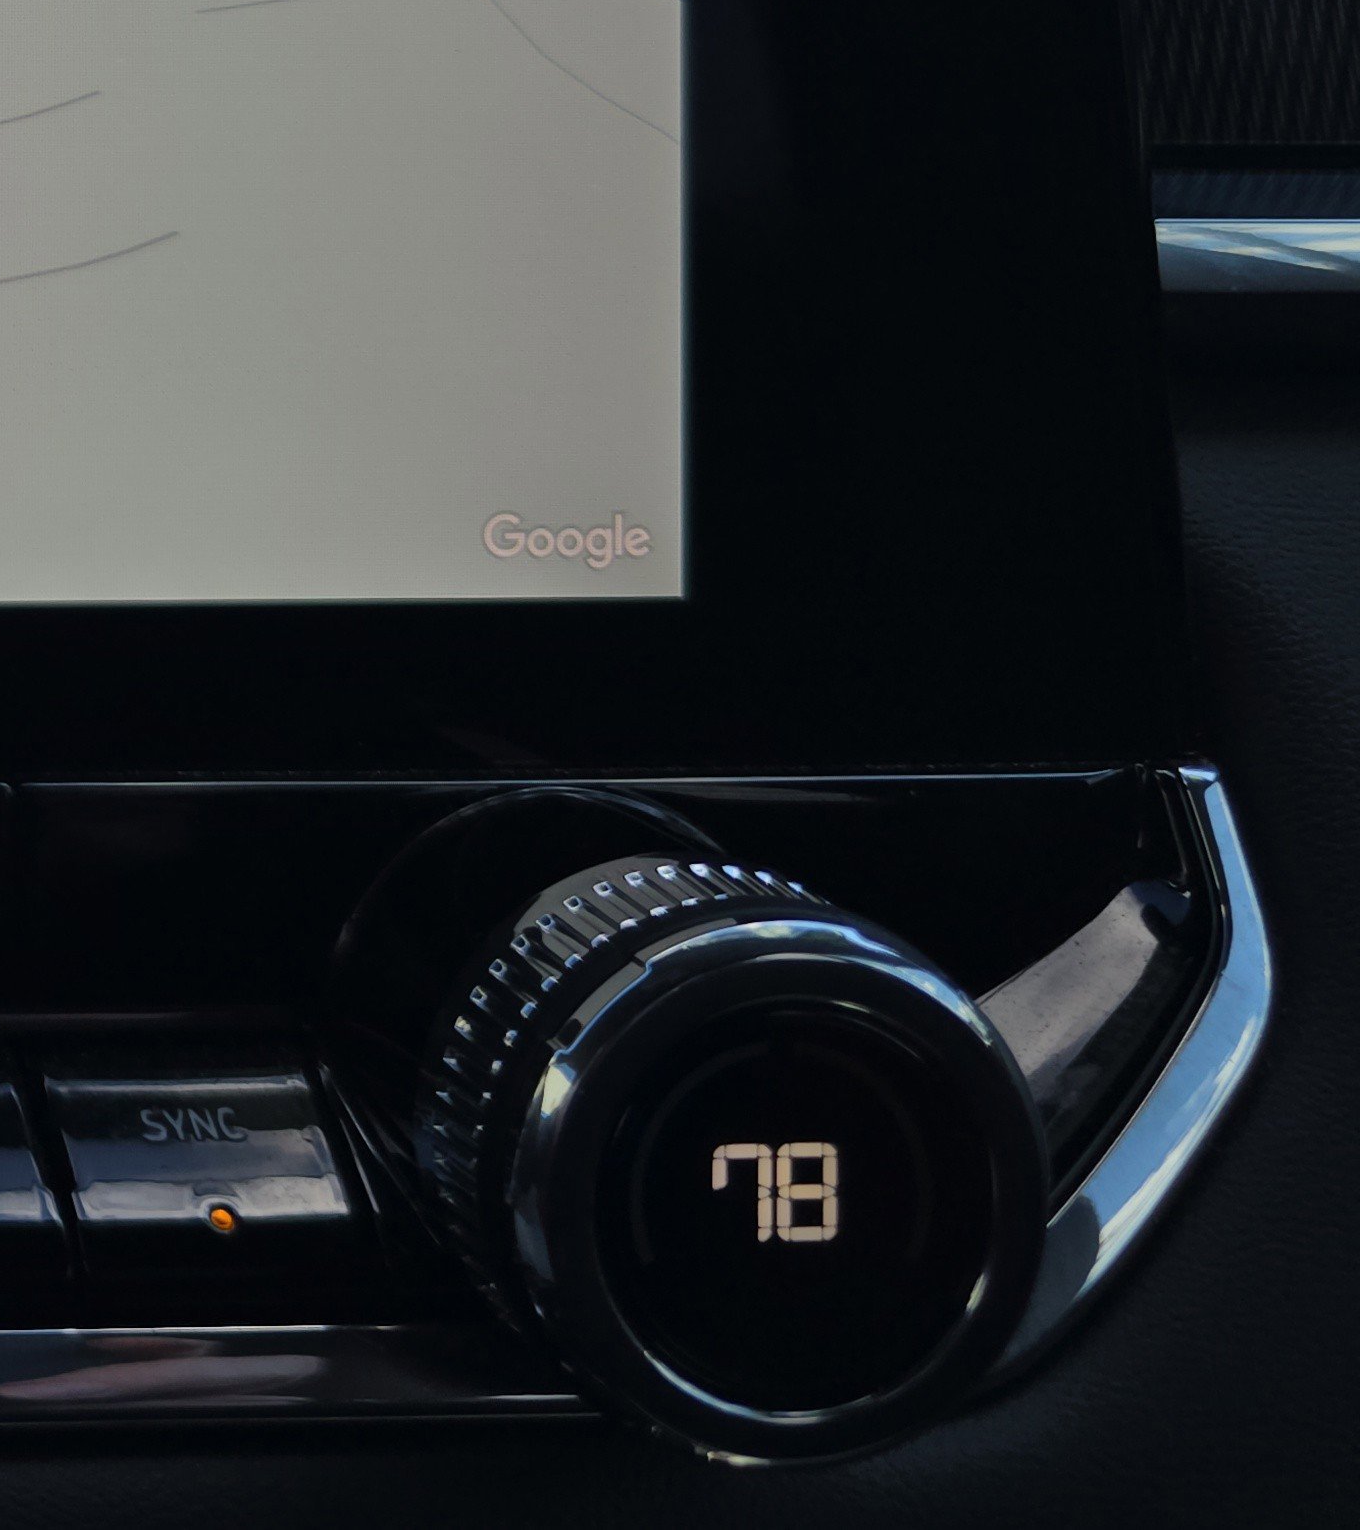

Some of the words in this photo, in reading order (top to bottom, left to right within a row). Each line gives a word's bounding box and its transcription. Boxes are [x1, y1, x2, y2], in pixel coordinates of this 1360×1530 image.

[483, 512, 651, 569] Google
[140, 1107, 248, 1143] SYNC
[711, 1141, 838, 1243] 78
